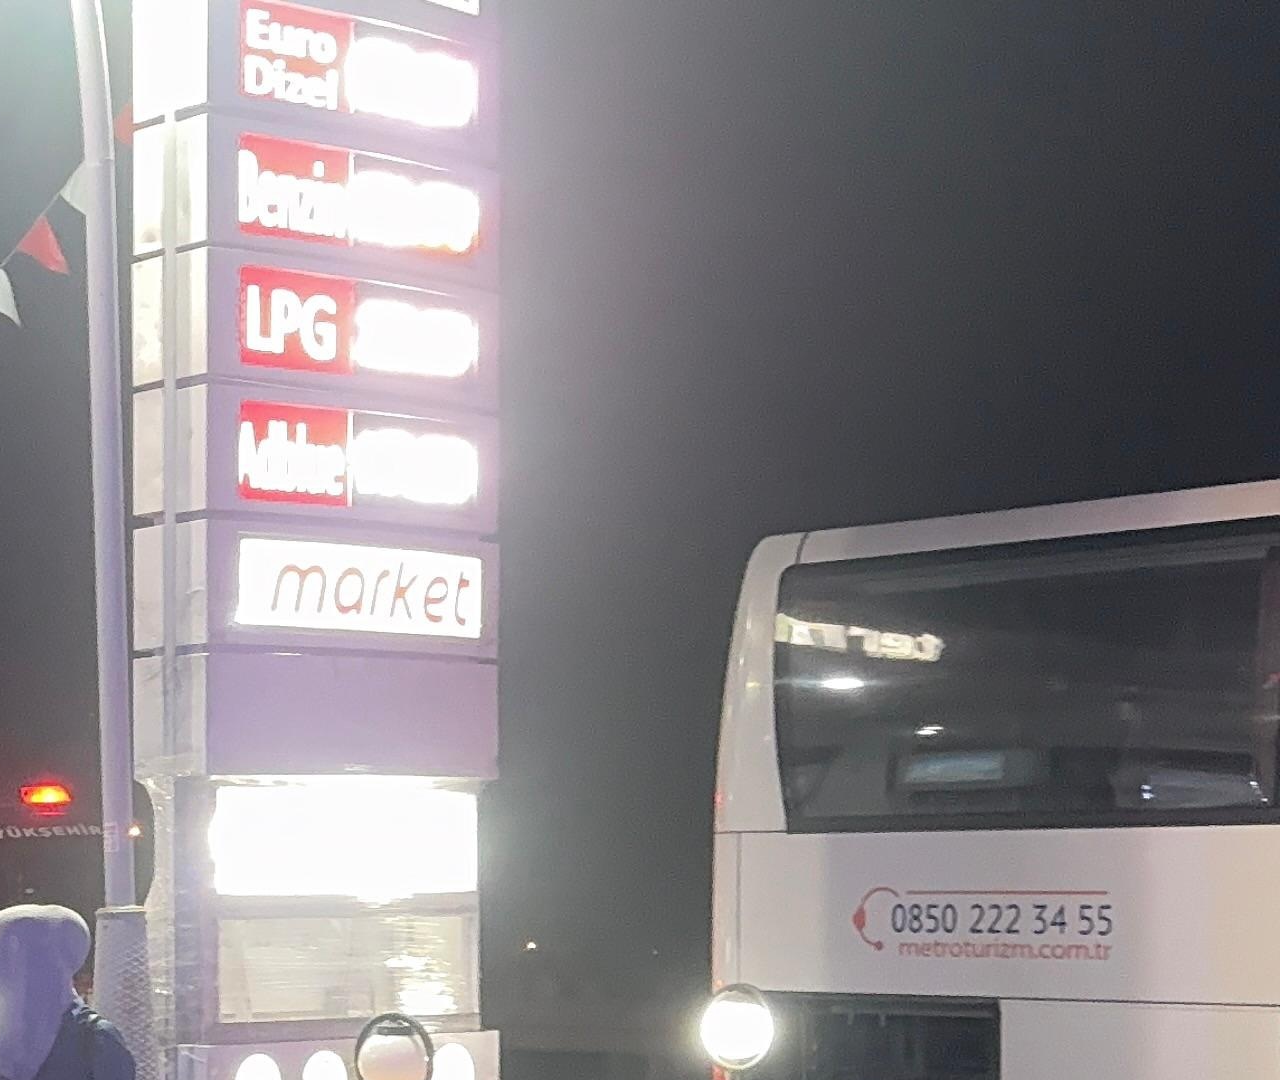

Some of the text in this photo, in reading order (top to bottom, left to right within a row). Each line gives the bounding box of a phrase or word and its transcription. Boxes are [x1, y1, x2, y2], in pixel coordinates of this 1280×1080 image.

[245, 8, 337, 63] Euro
[243, 54, 339, 111] Dizel
[245, 284, 338, 362] LPG
[270, 562, 471, 626] market
[890, 903, 1113, 936] 0850 222 34 55
[897, 939, 1113, 962] metroturizm.com.tr
